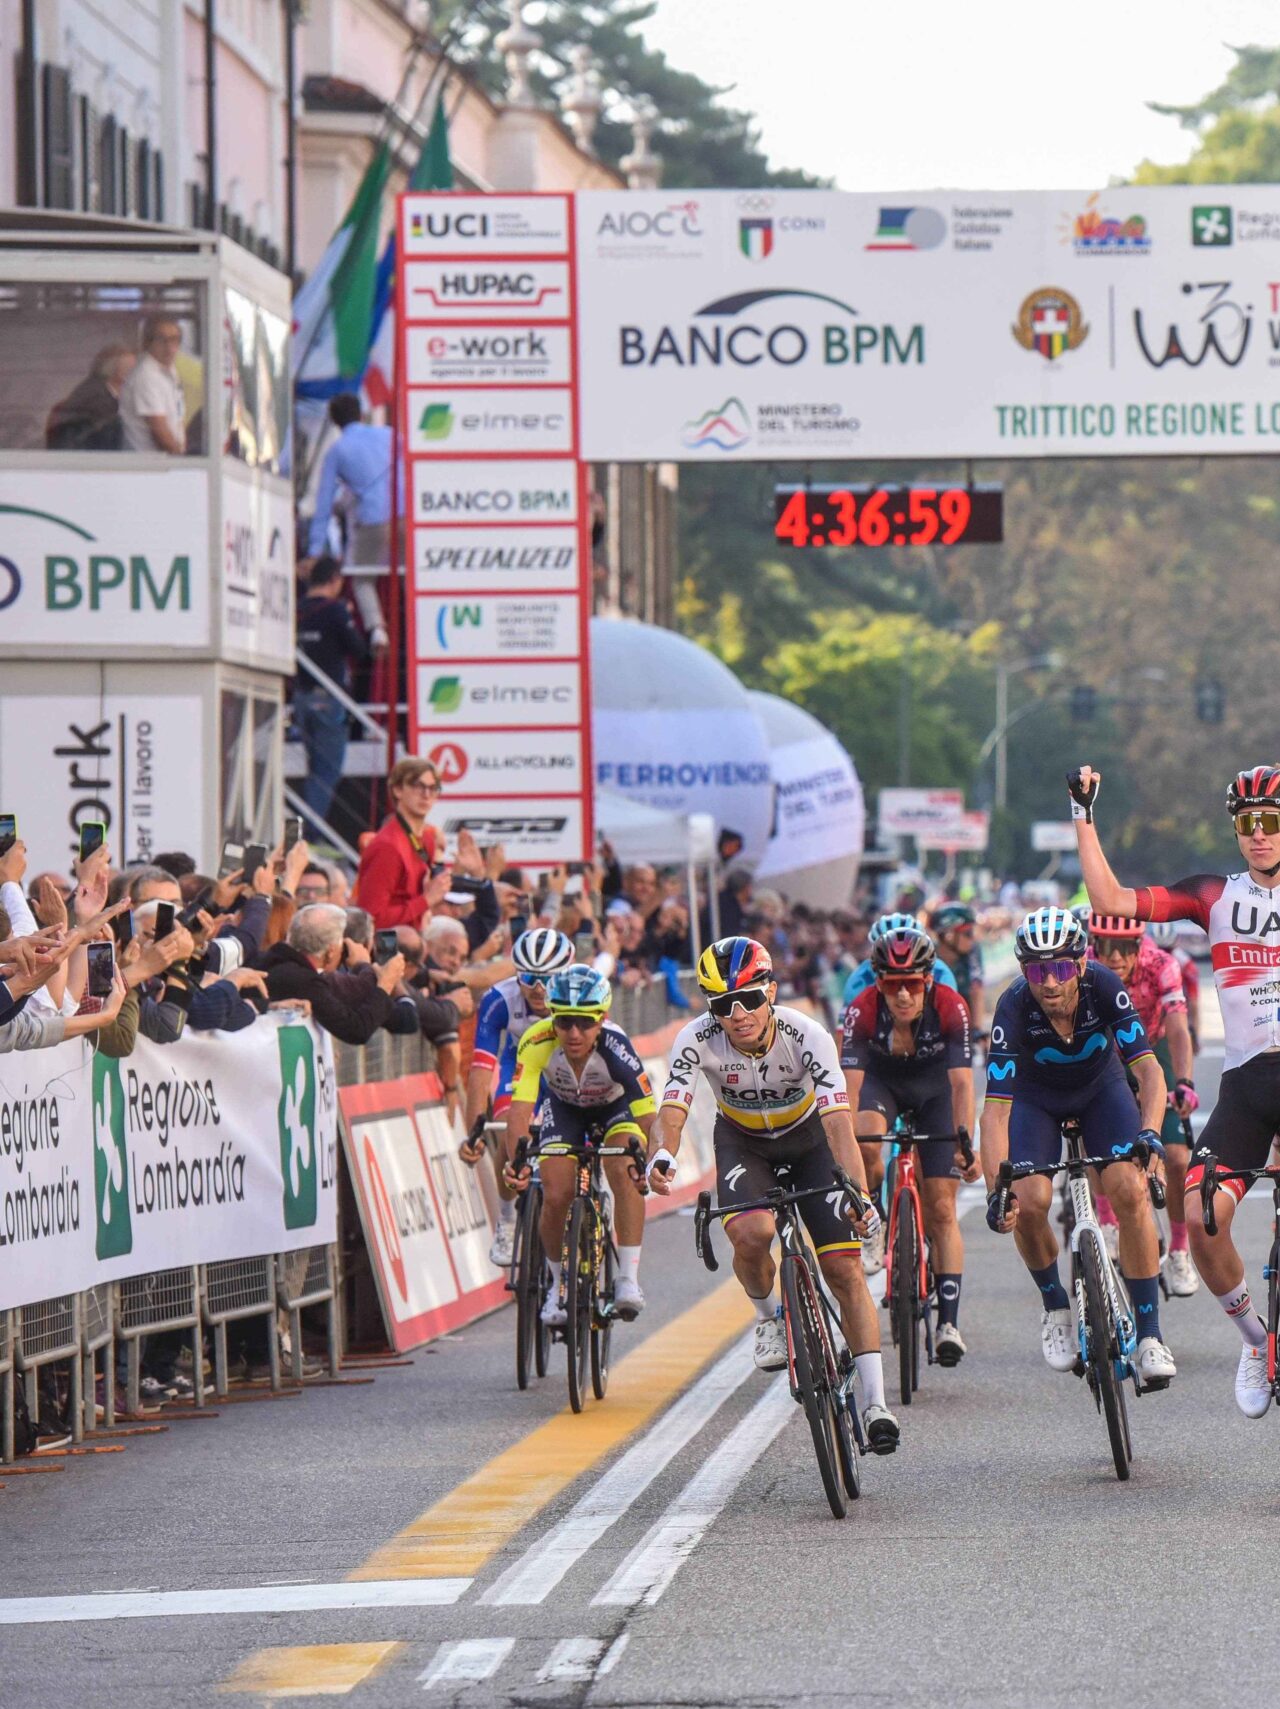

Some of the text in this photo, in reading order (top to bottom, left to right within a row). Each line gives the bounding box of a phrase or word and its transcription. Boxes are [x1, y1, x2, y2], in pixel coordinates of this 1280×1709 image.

[426, 213, 489, 238] UCI
[779, 217, 826, 232] CONI
[441, 273, 535, 296] HUPAC
[427, 329, 547, 358] e-work
[619, 323, 926, 367] BANCO BPM
[757, 402, 843, 417] MINISTERO
[757, 416, 862, 432] DEL TURISMO
[995, 404, 1116, 439] TRITTICO
[1126, 402, 1245, 437] REGIONE
[420, 489, 571, 512] BANCO BPM
[774, 488, 973, 547] 4:36:59
[421, 546, 575, 571] SPECIALIZED
[45, 554, 191, 612] BPM
[133, 720, 153, 796] lavoro
[777, 1018, 804, 1046] BORA
[842, 1006, 861, 1050] INEOS
[604, 1033, 641, 1072] Wallonie
[719, 1063, 747, 1072] LE COL
[127, 1066, 221, 1148] Regione
[720, 1085, 803, 1101] BORA
[0, 1084, 60, 1174] egione
[132, 1141, 246, 1215] Lombardia
